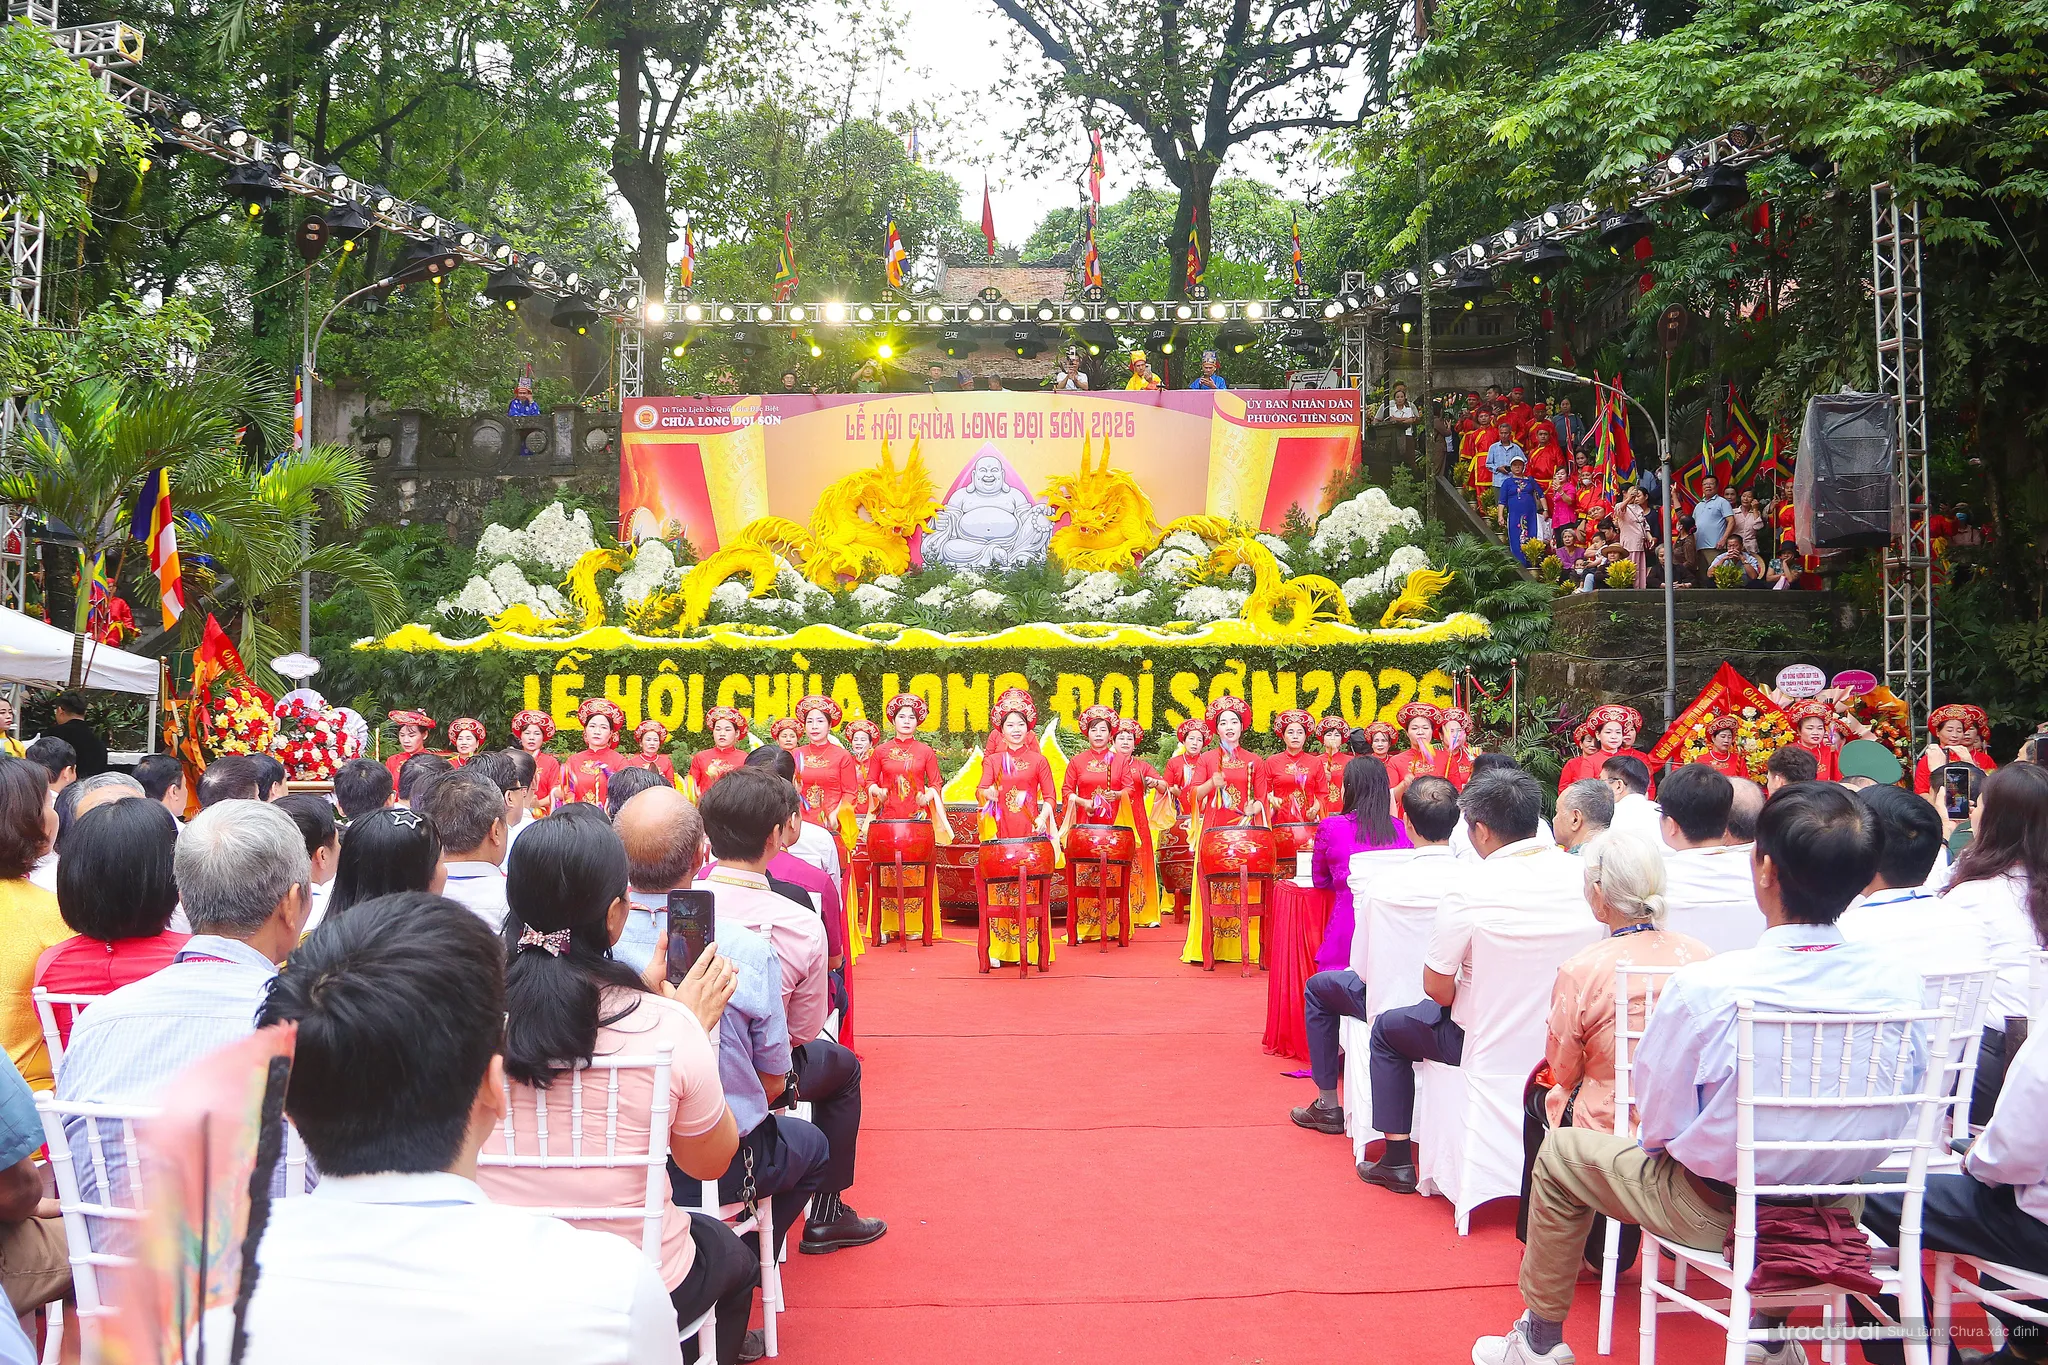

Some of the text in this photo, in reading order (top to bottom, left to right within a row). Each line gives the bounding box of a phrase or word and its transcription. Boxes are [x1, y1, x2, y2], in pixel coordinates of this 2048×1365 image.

[1246, 397, 1353, 409] ỦY BAN NHÂN DÂN
[689, 406, 704, 414] Lịch
[706, 405, 716, 413] Sử
[661, 414, 695, 427] CHÙA
[698, 416, 731, 427] LONG
[732, 416, 756, 428] ĐỌI
[757, 414, 782, 426] SƠN
[1247, 412, 1353, 423] PHƯỜNG TIÊN SƠN
[845, 403, 1136, 447] LỄ HỘI CHÙA LONG ĐỌI SƠN 2026
